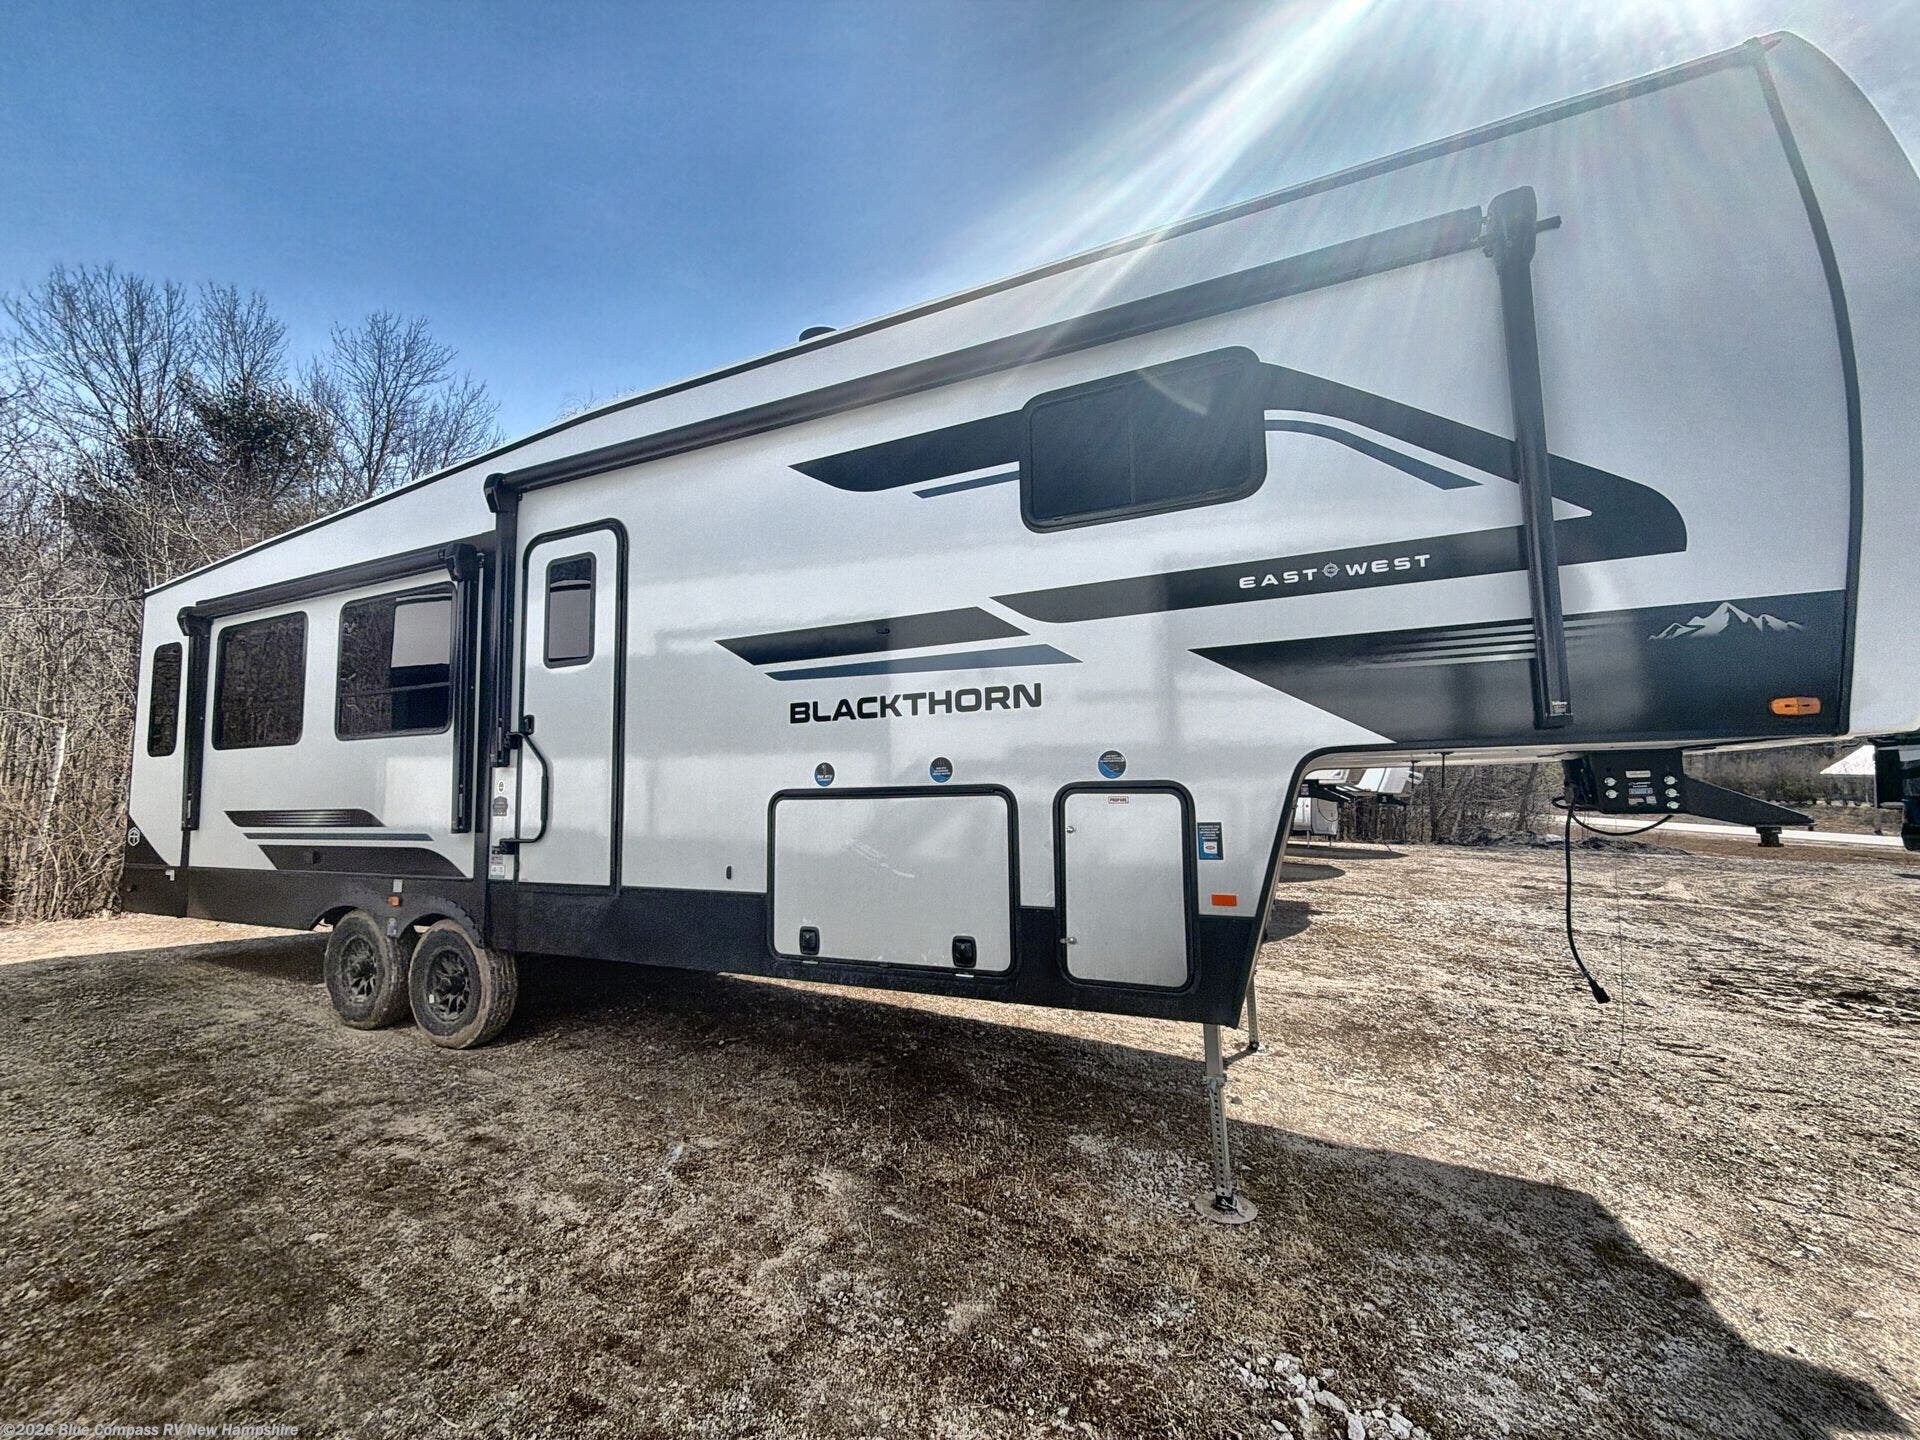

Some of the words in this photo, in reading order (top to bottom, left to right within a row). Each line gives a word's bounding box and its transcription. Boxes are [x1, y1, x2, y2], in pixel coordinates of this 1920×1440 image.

[1239, 568, 1318, 589] EAST
[1345, 554, 1431, 576] WEST
[789, 682, 1042, 724] BLACKTHORN
